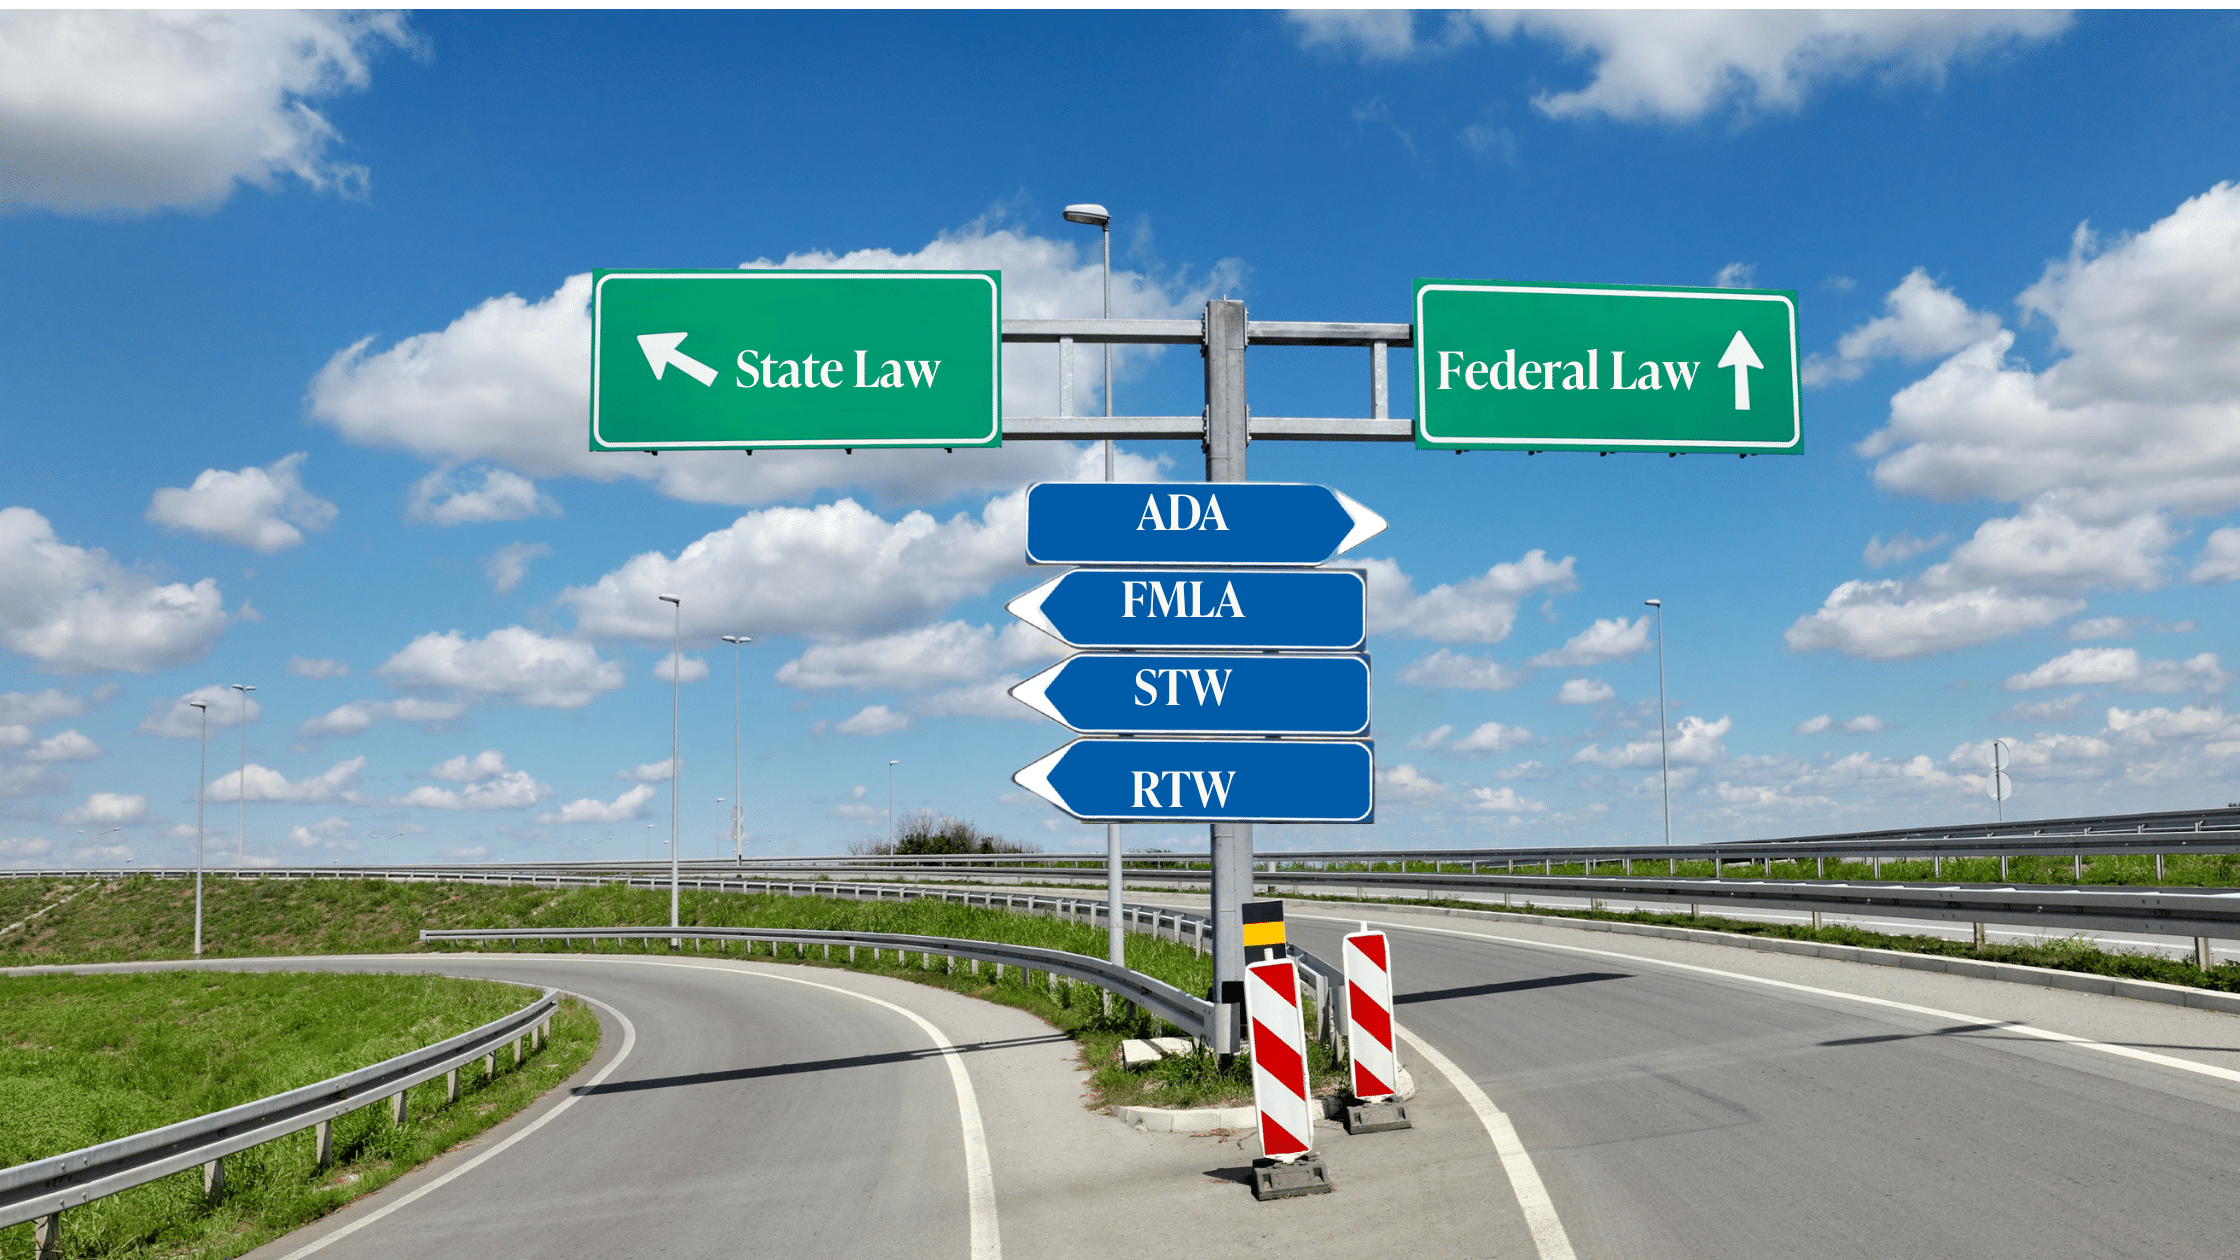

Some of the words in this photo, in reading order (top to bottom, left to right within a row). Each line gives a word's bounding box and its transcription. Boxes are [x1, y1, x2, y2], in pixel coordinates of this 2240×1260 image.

[735, 349, 844, 389] State
[852, 349, 942, 389] Law
[1436, 348, 1600, 391] Federal
[1609, 350, 1702, 391] Law
[1135, 493, 1230, 531] ADA
[1121, 580, 1246, 618] FMLA
[1134, 668, 1233, 707] STW
[1130, 770, 1237, 809] RTW
